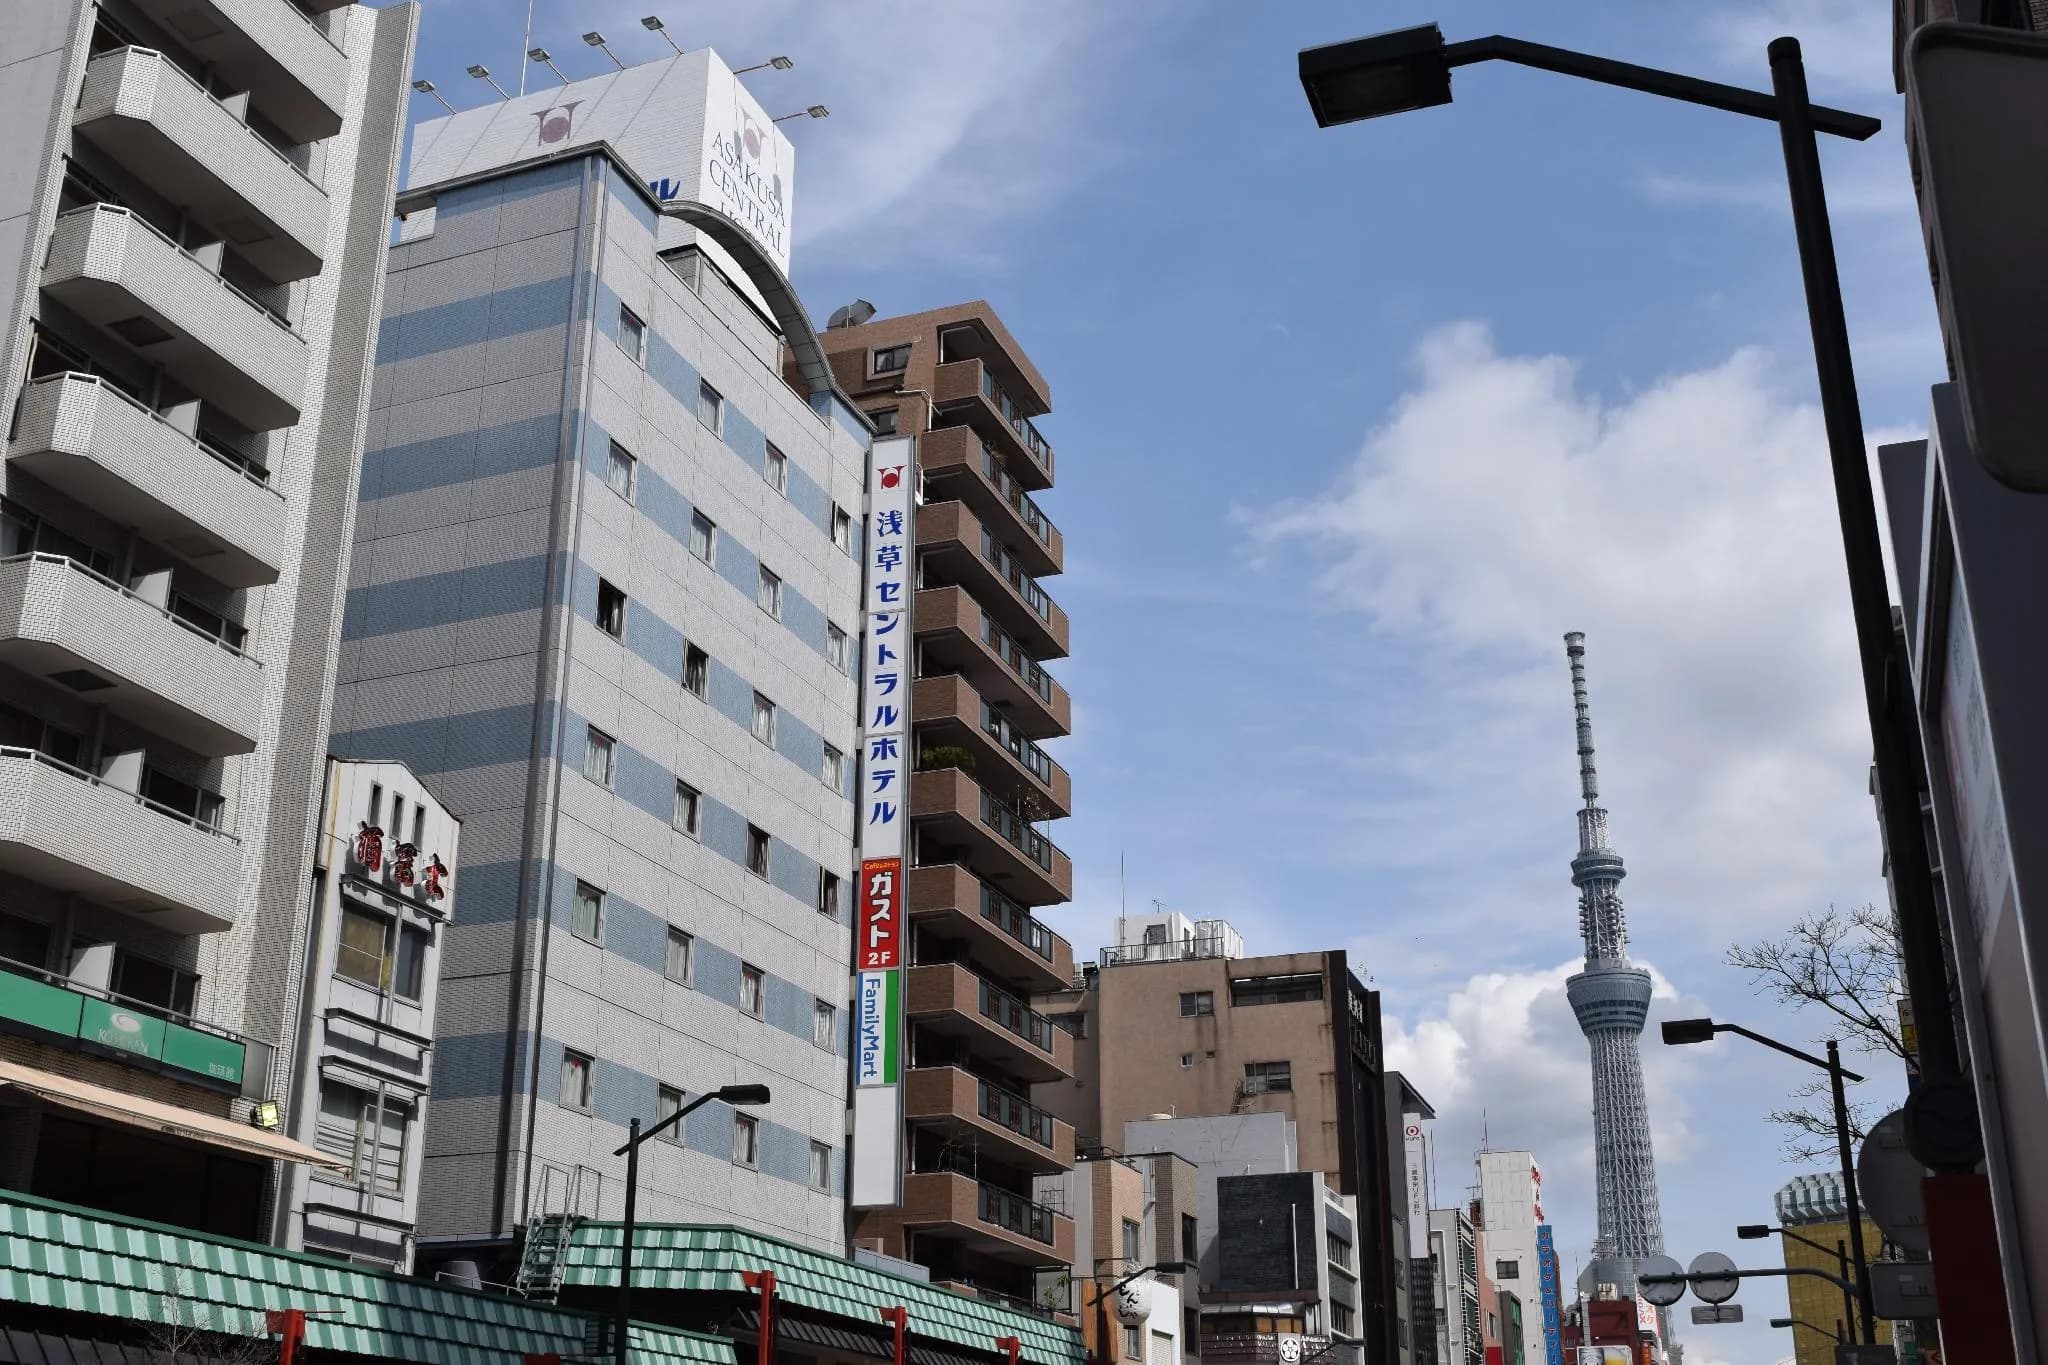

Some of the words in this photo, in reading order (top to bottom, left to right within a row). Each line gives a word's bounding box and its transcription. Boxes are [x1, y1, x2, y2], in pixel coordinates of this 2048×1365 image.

[709, 159, 786, 258] CENTRAL
[712, 131, 786, 228] ASAKUSA
[869, 510, 903, 826] 浅草セントラルホテル
[867, 950, 892, 965] 2F
[869, 871, 893, 948] ガスト
[863, 978, 881, 1078] FamilyMart
